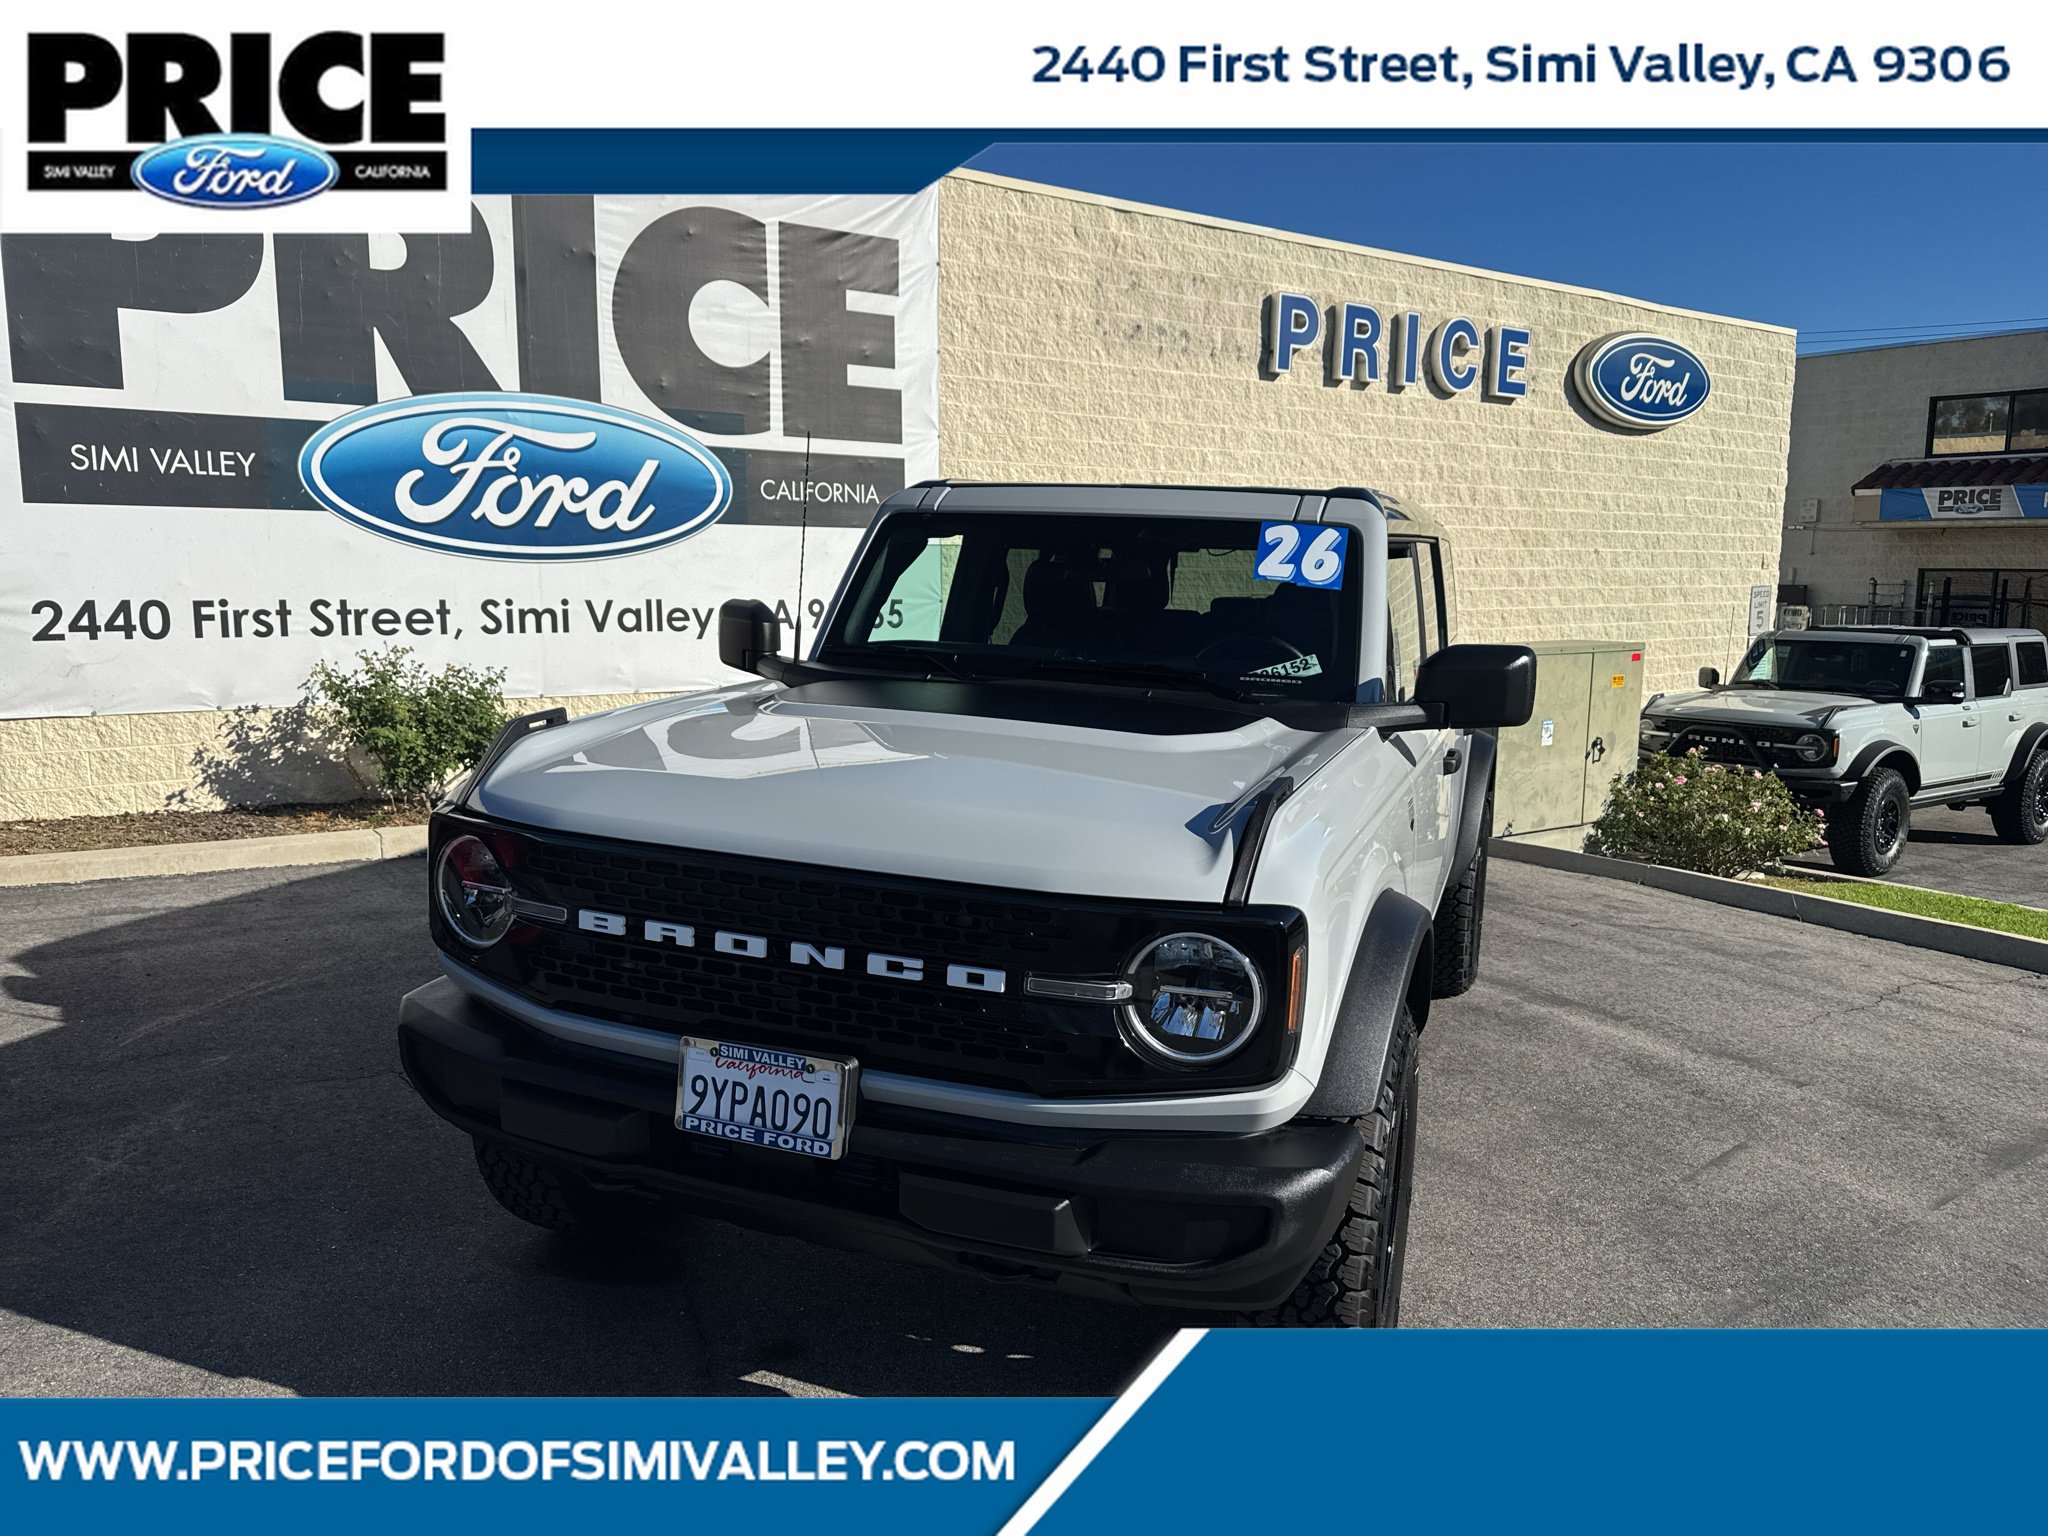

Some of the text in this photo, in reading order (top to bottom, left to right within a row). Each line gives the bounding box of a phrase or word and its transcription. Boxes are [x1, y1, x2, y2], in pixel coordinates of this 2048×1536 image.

[3, 194, 903, 444] PRICE
[1273, 292, 1531, 398] PRICE
[1620, 353, 1691, 407] Ford
[70, 443, 256, 477] SIMI VALLEY
[395, 417, 660, 531] Ford
[760, 478, 880, 505] CALIFORNIA
[1938, 489, 2002, 506] PRICE
[1257, 524, 1342, 585] 26
[1753, 590, 1770, 599] SPEED
[1753, 601, 1768, 609] LIMIT
[32, 599, 171, 642] 2440
[193, 598, 292, 638] First
[309, 598, 463, 640] Street,
[480, 598, 570, 635] Simi
[1756, 610, 1764, 629] 5
[578, 908, 1006, 993] BRONCO
[719, 1045, 806, 1069] SIMI VALLEY
[687, 1074, 832, 1140] 9YPA090
[685, 1116, 831, 1156] PRICE FORD
